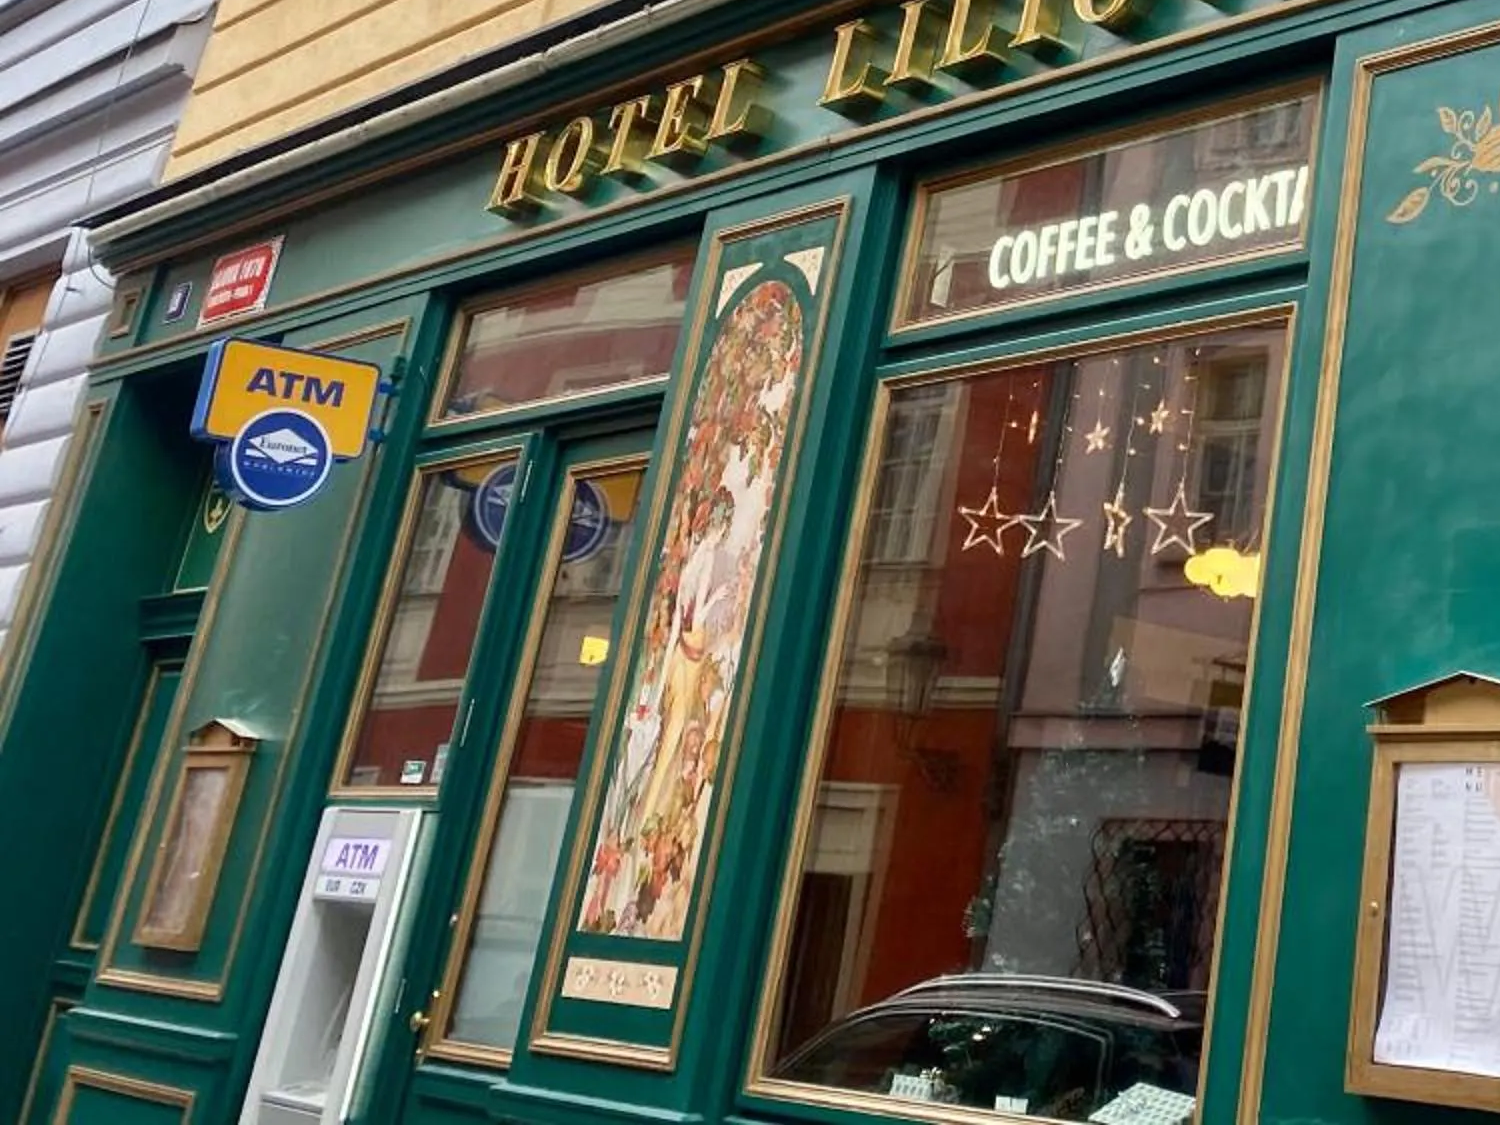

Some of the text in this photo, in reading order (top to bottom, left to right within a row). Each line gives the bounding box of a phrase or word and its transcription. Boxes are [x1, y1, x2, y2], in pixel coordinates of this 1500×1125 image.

[484, 59, 770, 216] HOTEL
[988, 210, 1118, 289] COFFEE
[1124, 203, 1154, 259] &
[246, 367, 345, 408] ATM
[335, 842, 380, 871] ATM
